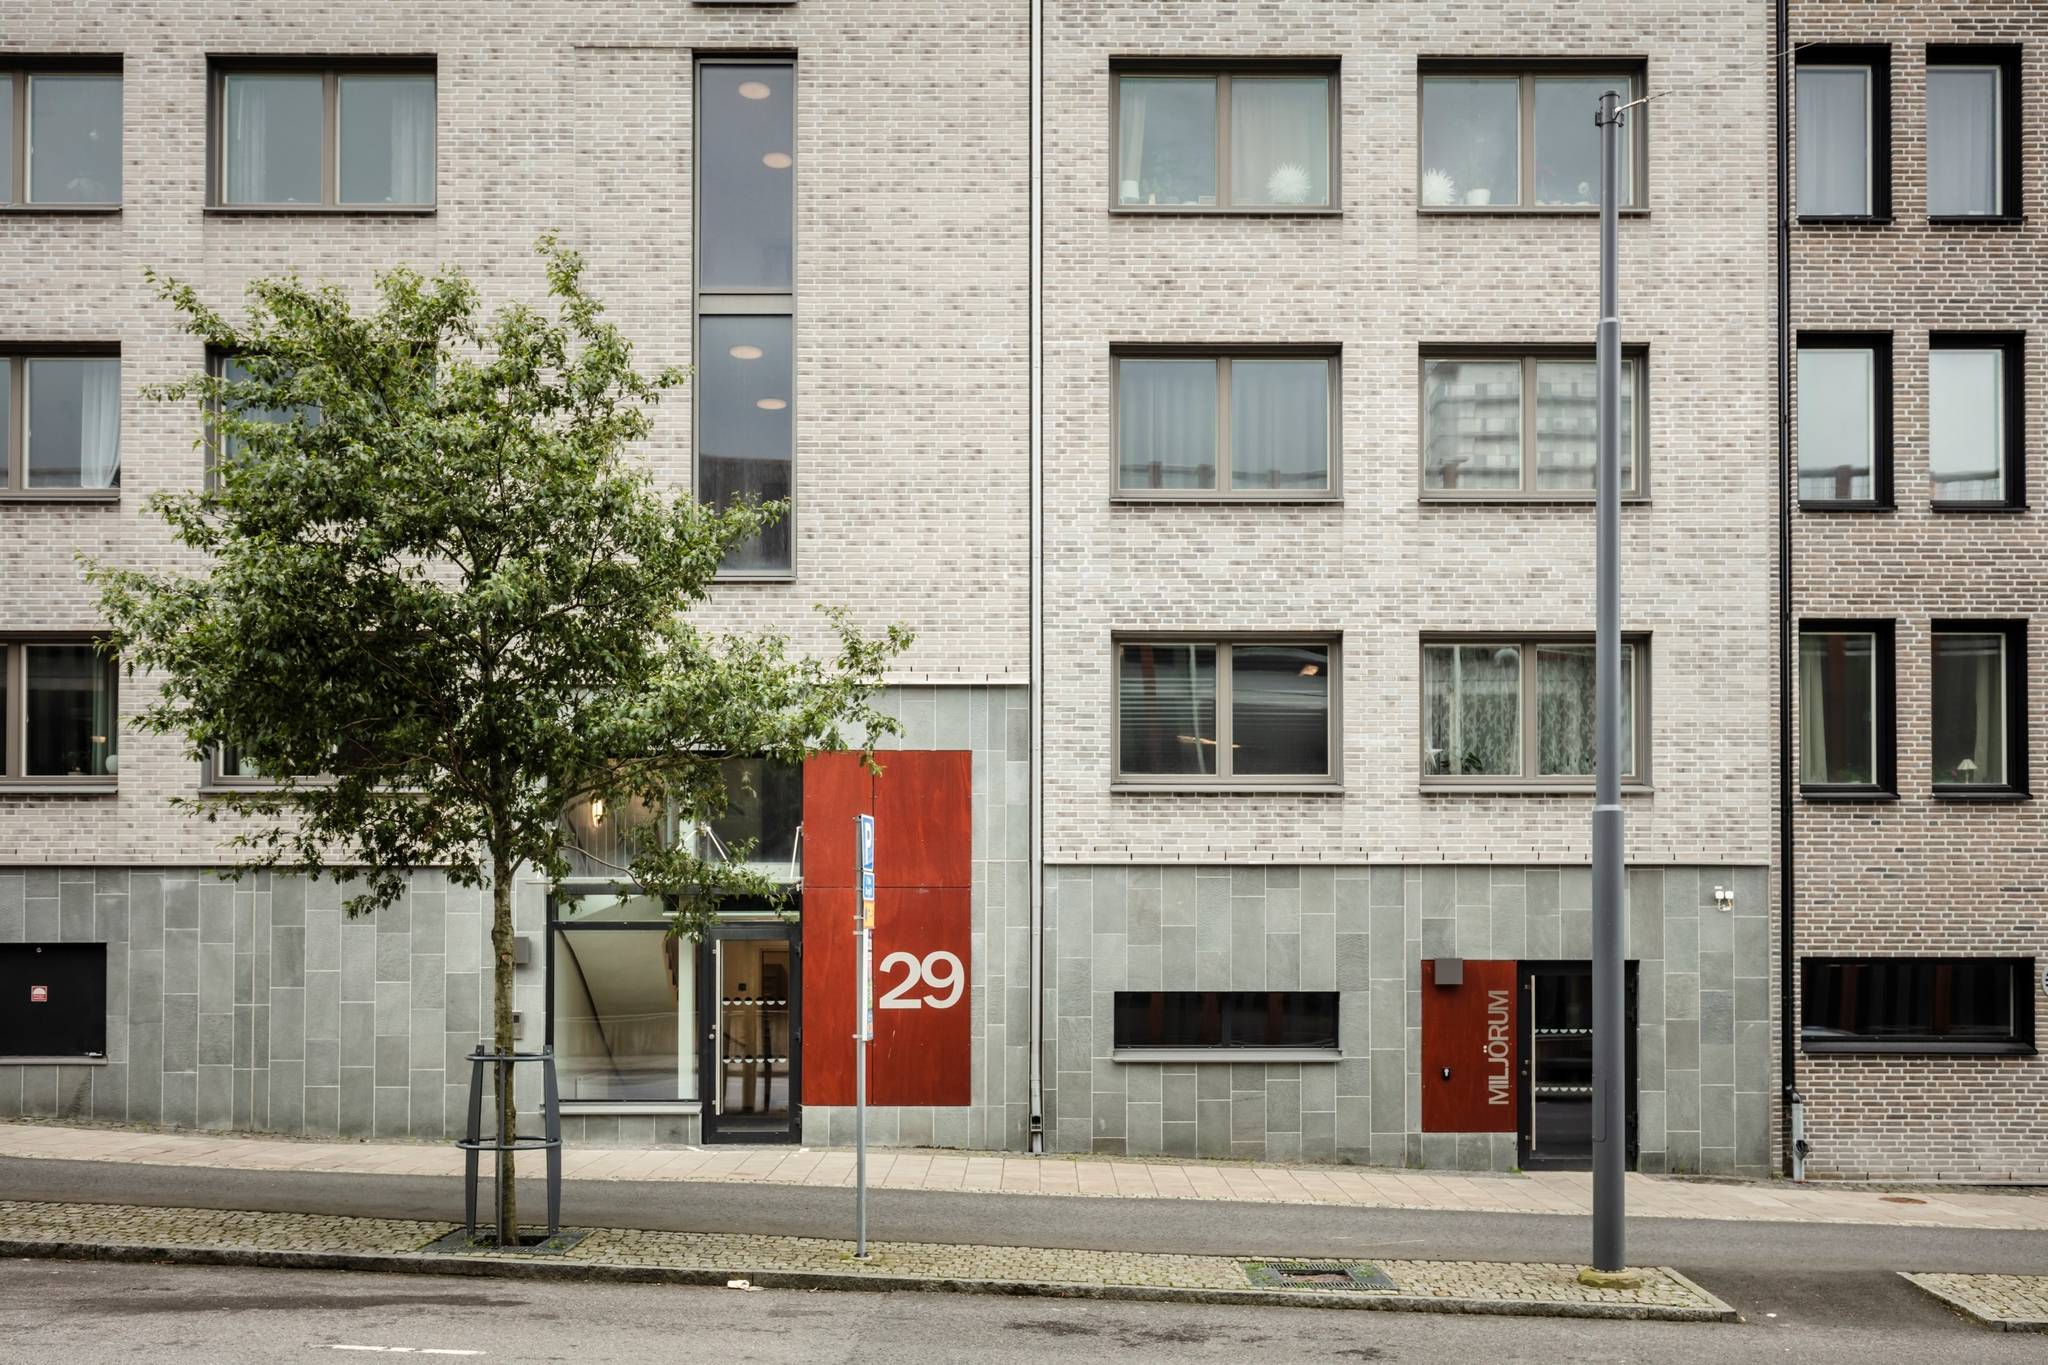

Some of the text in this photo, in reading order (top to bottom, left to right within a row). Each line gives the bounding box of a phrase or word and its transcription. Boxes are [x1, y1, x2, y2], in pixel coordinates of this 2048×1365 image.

[864, 822, 872, 864] P
[879, 950, 965, 1009] 29
[1483, 990, 1510, 1105] MILJÖRUM
